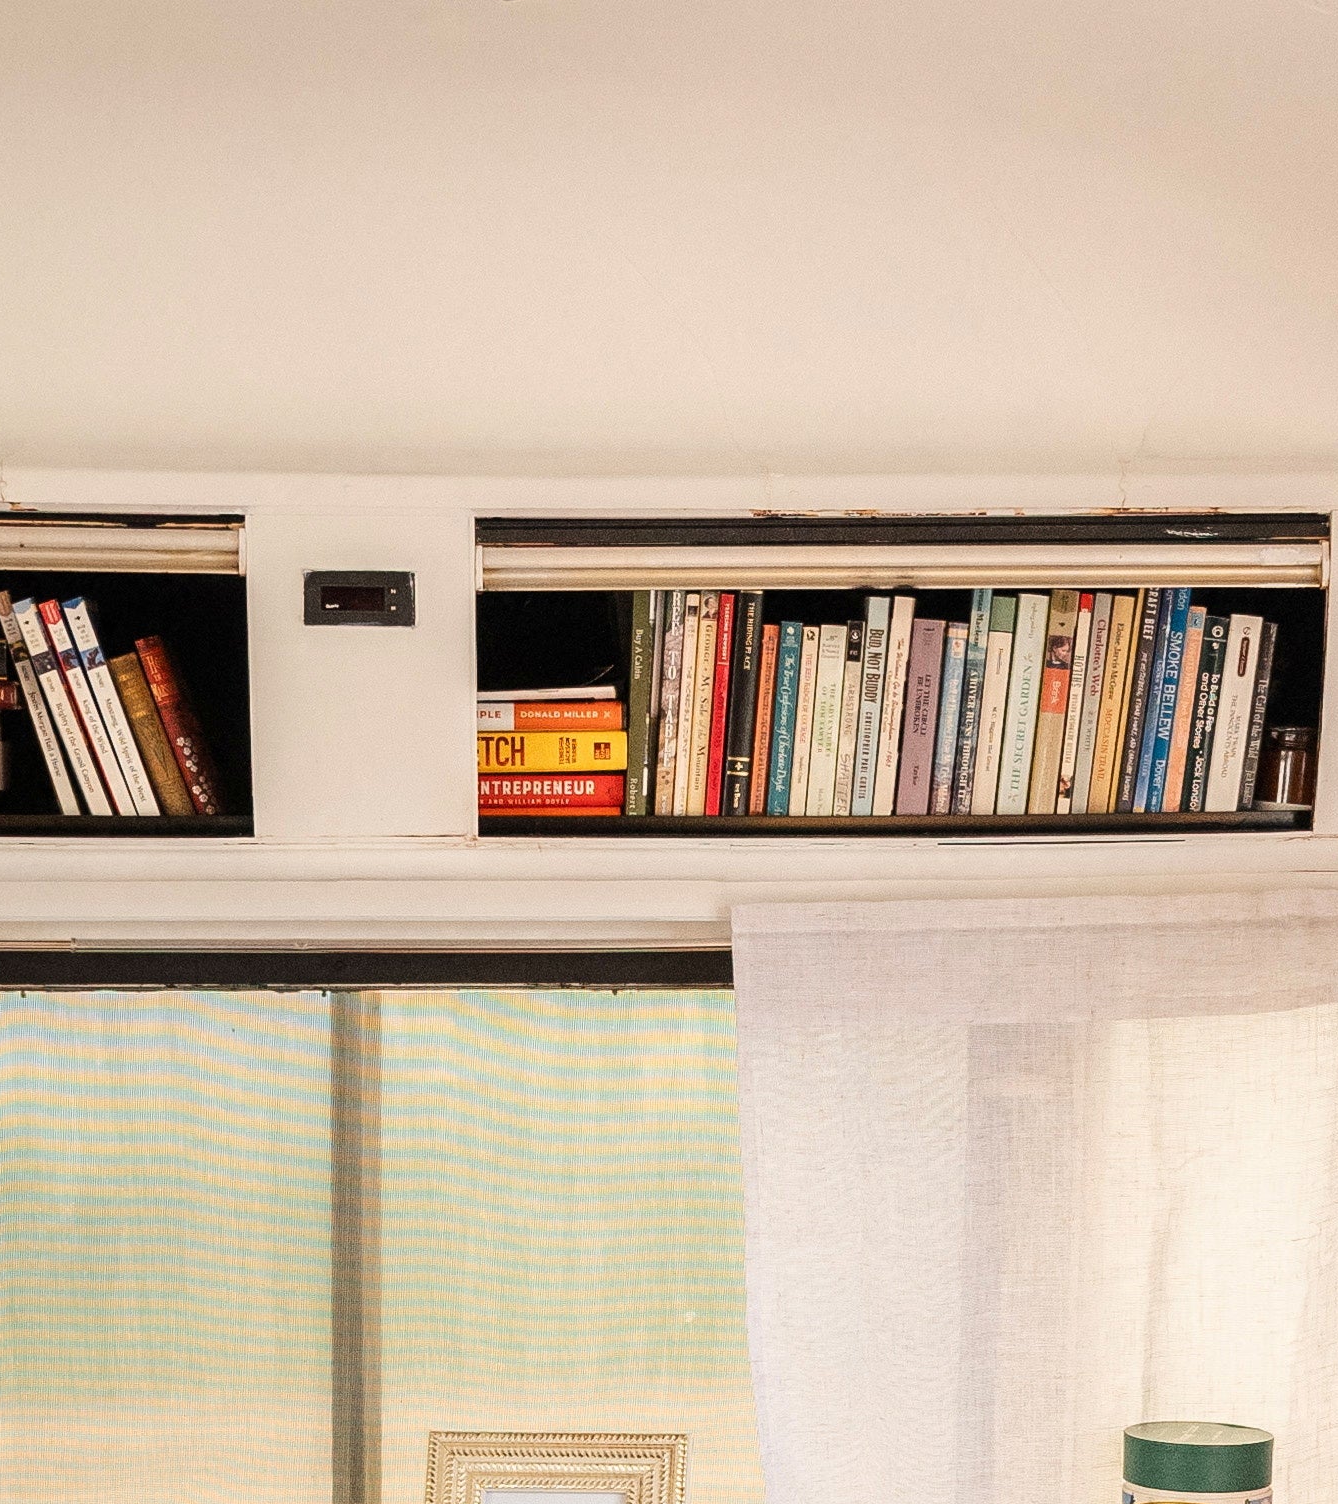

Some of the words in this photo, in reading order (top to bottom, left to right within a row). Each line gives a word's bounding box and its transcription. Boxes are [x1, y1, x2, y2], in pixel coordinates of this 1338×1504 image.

[746, 602, 755, 618] THE
[634, 629, 644, 645] Buy
[703, 624, 714, 665] GEORGE
[744, 618, 754, 646] HIDING
[866, 628, 885, 650] BUD,
[1113, 622, 1125, 645] Eloise
[636, 646, 642, 654] A
[743, 646, 751, 670] PLACE
[1092, 619, 1107, 672] Charlotte's
[1111, 645, 1122, 669] Jarvis
[1166, 630, 1183, 679] SMOKE
[634, 655, 643, 679] Cabin
[667, 651, 678, 680] TO
[866, 652, 882, 670] NOT
[1072, 655, 1085, 688] SHILOH
[700, 675, 711, 693] My
[783, 669, 793, 686] True
[864, 672, 881, 705] BUDDY
[1090, 674, 1102, 697] Web
[1200, 672, 1210, 692] and
[1210, 673, 1221, 684] To
[1257, 678, 1268, 694] The
[966, 678, 977, 708] RIVER
[1018, 665, 1032, 718] GARDEN
[1051, 680, 1061, 705] Brink
[1208, 684, 1219, 707] Build
[1254, 695, 1267, 713] Call
[520, 711, 561, 719] DONALD
[563, 711, 598, 719] MILLER
[699, 695, 709, 716] Side
[778, 686, 793, 726] Confessions
[844, 683, 855, 736] ARMSTRONG
[912, 688, 923, 734] UNBROKEN
[1157, 684, 1177, 741] BELLEW
[1197, 693, 1208, 718] Other
[825, 703, 835, 758] ADVENTURES
[920, 708, 929, 737] CIRCLE
[965, 711, 974, 737] RUNS
[1100, 707, 1114, 754] MOCCASIN
[1205, 715, 1215, 732] Fire
[1251, 725, 1262, 737] the
[1254, 713, 1264, 724] of
[663, 694, 677, 769] TABLE
[862, 711, 874, 755] CHRISTOPHER
[1014, 721, 1027, 764] SECRET
[1193, 719, 1205, 749] Stories
[777, 735, 790, 771] Charlotte
[1248, 739, 1261, 759] Wild
[694, 744, 705, 791] Mountain
[861, 758, 870, 773] PAUL
[959, 739, 971, 785] THROUGH
[1096, 754, 1107, 782] TRAIL
[1152, 759, 1165, 788] Dover
[1221, 749, 1232, 778] ABROAD
[775, 770, 786, 792] Doyle
[858, 776, 868, 799] CURTIS
[1011, 765, 1022, 791] THE
[1245, 769, 1256, 784] Jack
[629, 777, 638, 809] Robert
